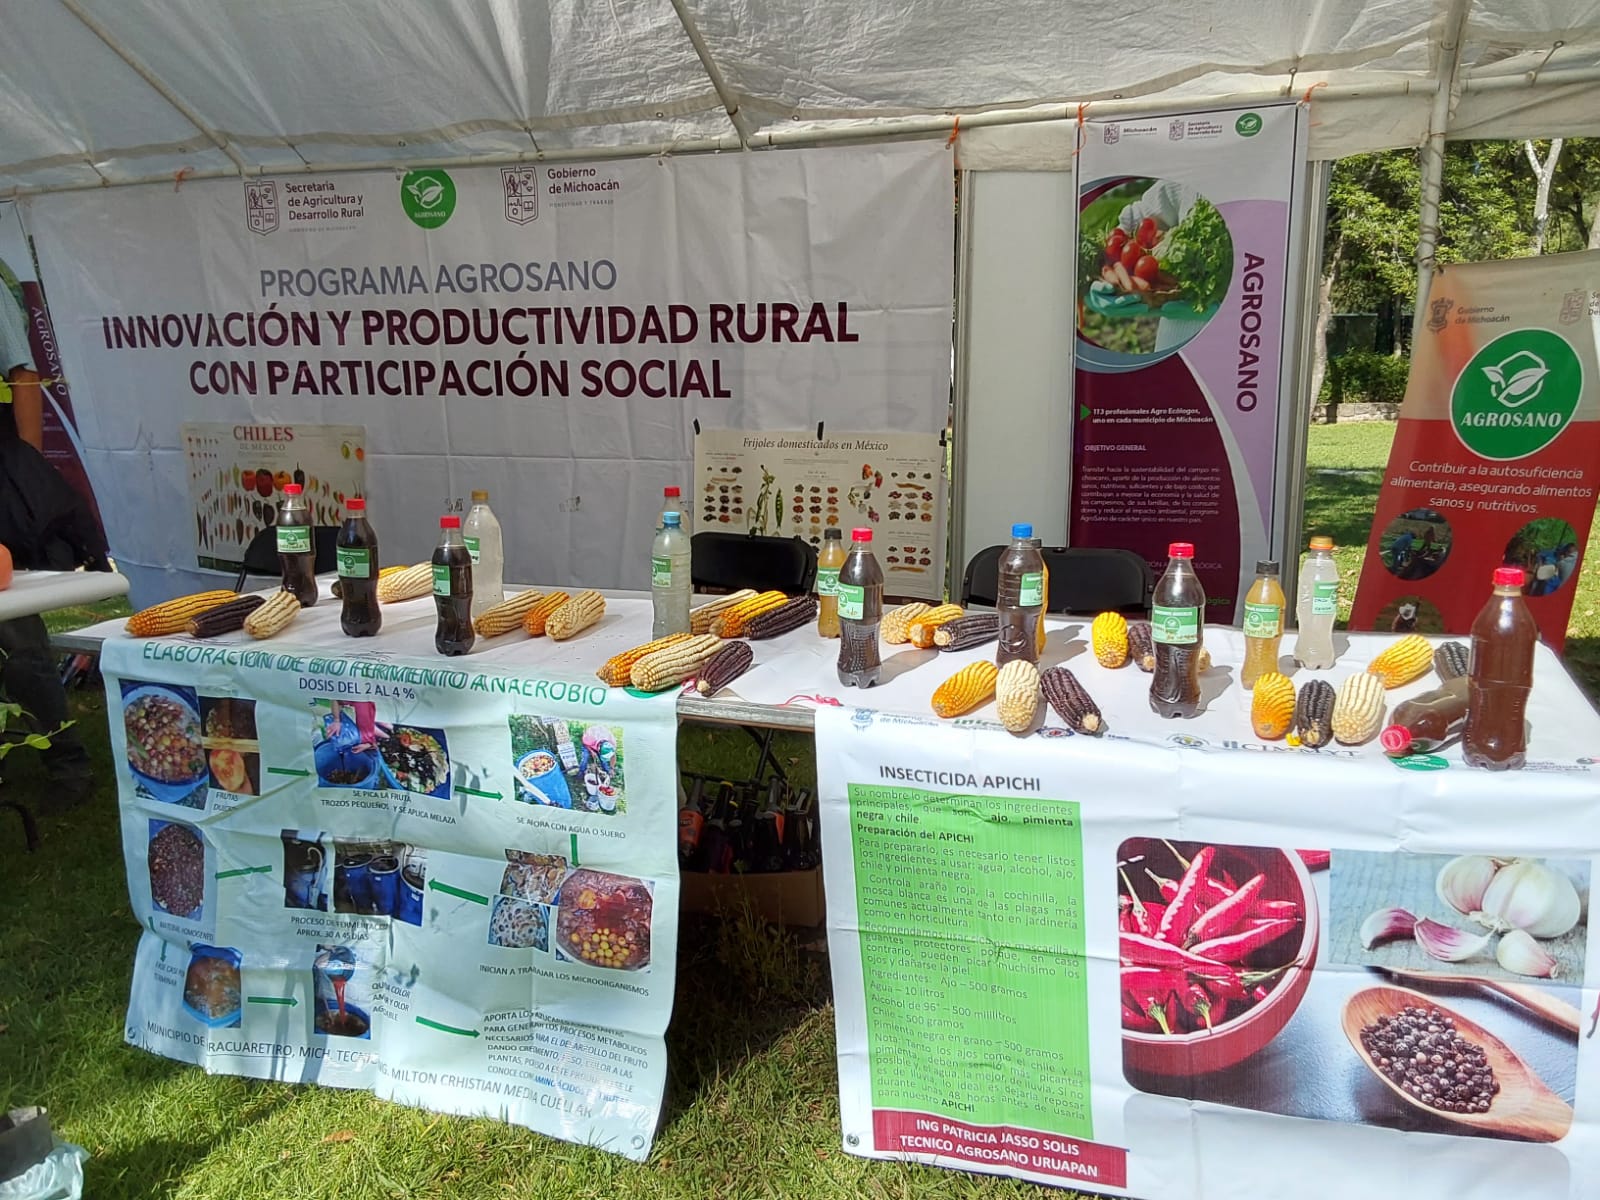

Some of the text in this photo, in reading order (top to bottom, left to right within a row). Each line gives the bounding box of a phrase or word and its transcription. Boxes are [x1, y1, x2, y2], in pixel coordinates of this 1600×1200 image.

[547, 167, 596, 180] Gobierno
[549, 179, 619, 194] de Michoacán
[288, 194, 363, 209] de Agricultura y
[289, 207, 364, 220] Desarrollo Rural
[260, 259, 617, 298] PROGRAMA AGROSANO
[102, 301, 859, 349] INNOVACIÓN Y PRODUCTIVIDAD RURAL
[1467, 314, 1510, 324] Michoacán
[1236, 252, 1265, 412] AGROSANO
[189, 350, 731, 398] CON PARTICIPACIÓN SOCIAL
[1116, 416, 1132, 424] cada
[1133, 416, 1166, 425] municipio
[1167, 416, 1176, 424] de
[1150, 408, 1167, 417] Agro
[1460, 412, 1562, 428] AGROSANO
[233, 425, 294, 442] CHILES
[743, 437, 888, 451] Frijoles domesticados en México
[1084, 444, 1146, 452] OBJETIVO GENERAL
[1409, 460, 1583, 480] Contribuir a la autosuficiencia
[1390, 476, 1592, 497] alimentaria, asegurando alimentos
[1428, 497, 1539, 514] sanos y nutritivos.
[299, 677, 415, 699] DOSIS DEL 2 AL 4 %
[470, 674, 606, 706] ANAEROBIO
[879, 764, 1041, 792] INSECTICIDA APICHI
[363, 790, 379, 798] PICA
[380, 791, 389, 799] LA
[391, 793, 412, 803] FRUTA
[854, 787, 866, 796] Su
[869, 789, 909, 800] nombre
[911, 791, 921, 801] lo
[985, 800, 1001, 809] los
[1004, 801, 1073, 816] ingredientes
[408, 808, 428, 819] APLICA
[430, 812, 456, 825] MELAZA
[856, 799, 913, 812] principales,
[922, 805, 942, 814] que
[1023, 816, 1073, 827] pimienta
[856, 810, 884, 821] negra
[551, 822, 626, 839] CON AGUA SUERO
[857, 823, 974, 844] Preparación del APICHI
[858, 837, 1077, 867] Para prepararlo, es necesario tener listos
[859, 848, 1077, 880] los ingredientes usar: agua, alcohol, ajo,
[860, 860, 883, 870] chile
[894, 864, 938, 877] pimienta
[869, 874, 911, 888] Controla
[919, 881, 947, 891] araña
[985, 889, 995, 899] la
[1004, 891, 1058, 905] cochinilla,
[1067, 896, 1077, 906] la
[862, 886, 1078, 918] mosca blanca es una de las plagas más
[290, 916, 325, 926] PROCESO
[325, 930, 334, 938] 30
[479, 964, 649, 997] INICIAN LOS MICROORGANISMOS
[484, 1009, 534, 1022] APORTA LOS
[146, 1020, 191, 1043] MUNICIPIO
[192, 1034, 205, 1047] DE
[485, 1032, 535, 1042] NECESARIOS
[608, 1051, 622, 1062] DEL
[624, 1055, 648, 1069] FRUTO
[391, 1068, 437, 1085] MILTON
[440, 1074, 501, 1095] CRHISTIAN
[620, 1068, 632, 1079] LAS
[916, 1119, 1079, 1156] ING PATRICIA JASSO SOLIS
[900, 1135, 1098, 1177] TECNICO AGROSANO URUAPAN
